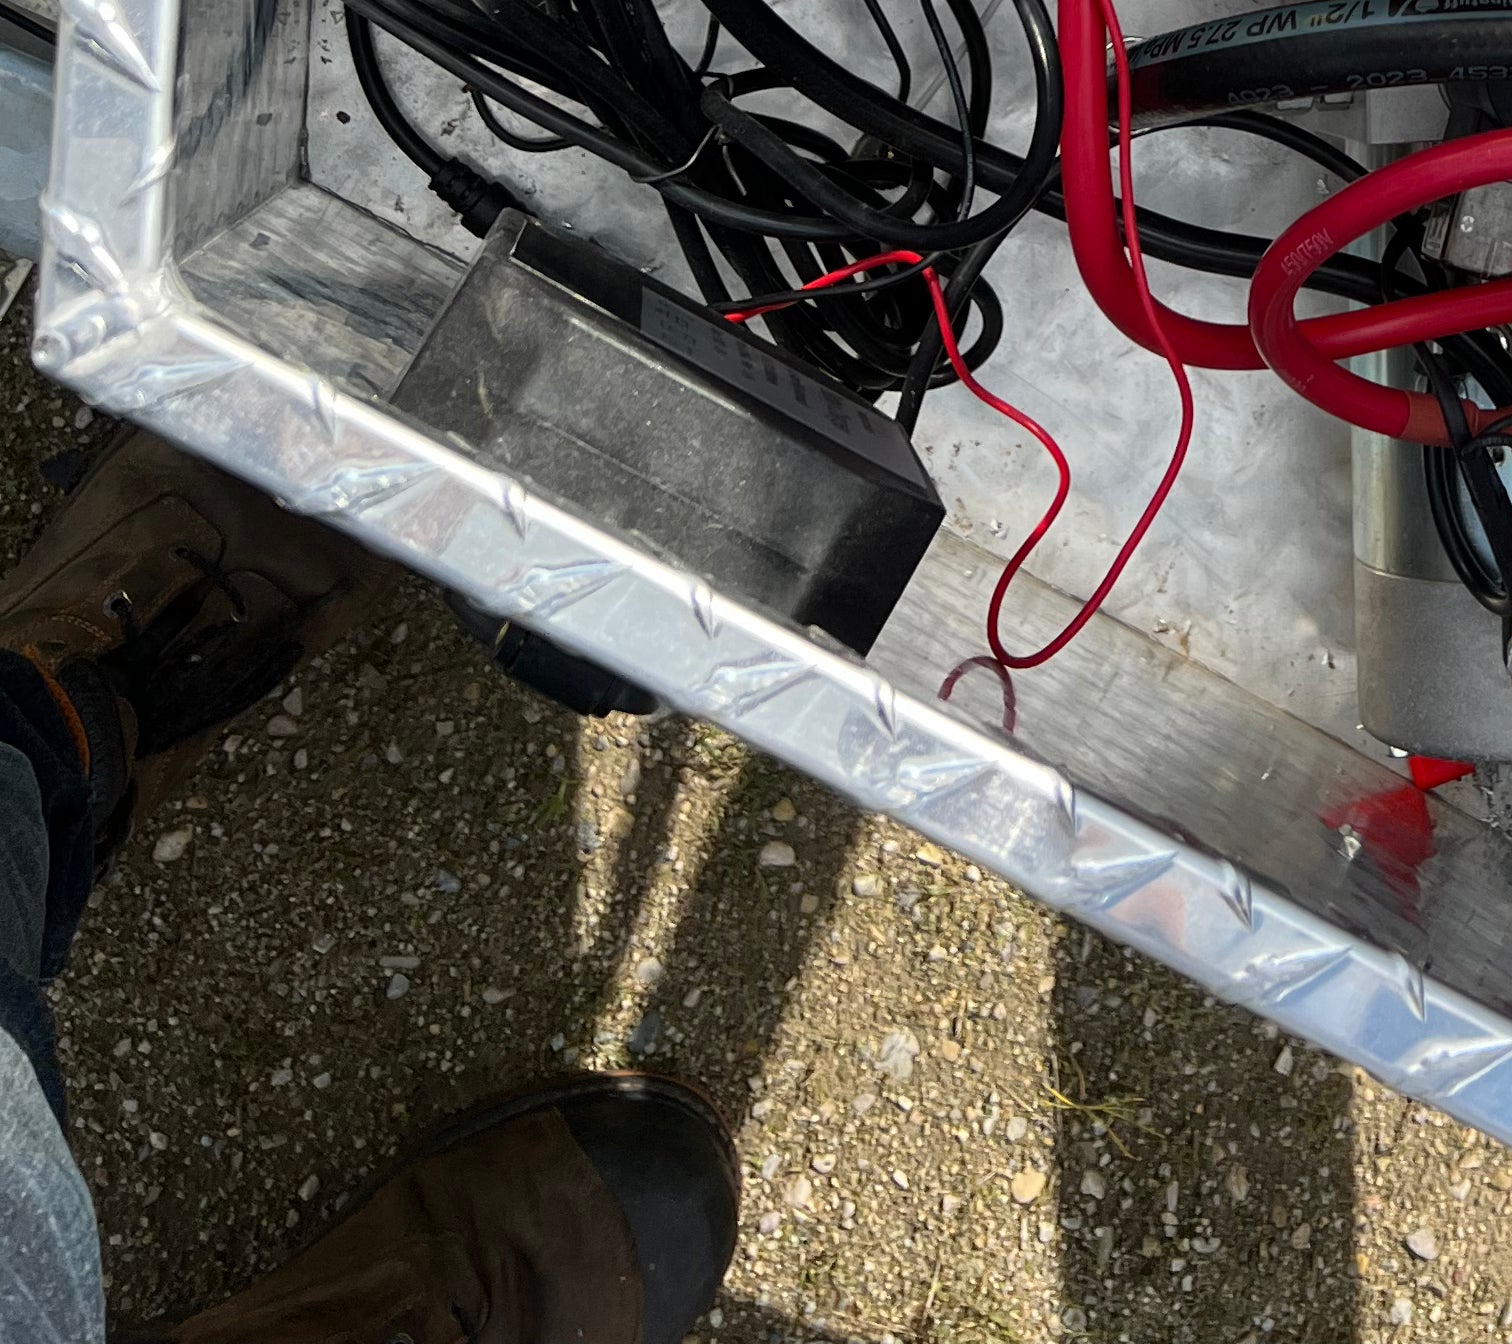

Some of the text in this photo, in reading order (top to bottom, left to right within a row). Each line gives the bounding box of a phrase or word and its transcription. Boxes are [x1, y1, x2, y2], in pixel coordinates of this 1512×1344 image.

[1247, 10, 1297, 36] WP
[1310, 0, 1375, 26] 1/2"
[1187, 20, 1241, 49] 27.5
